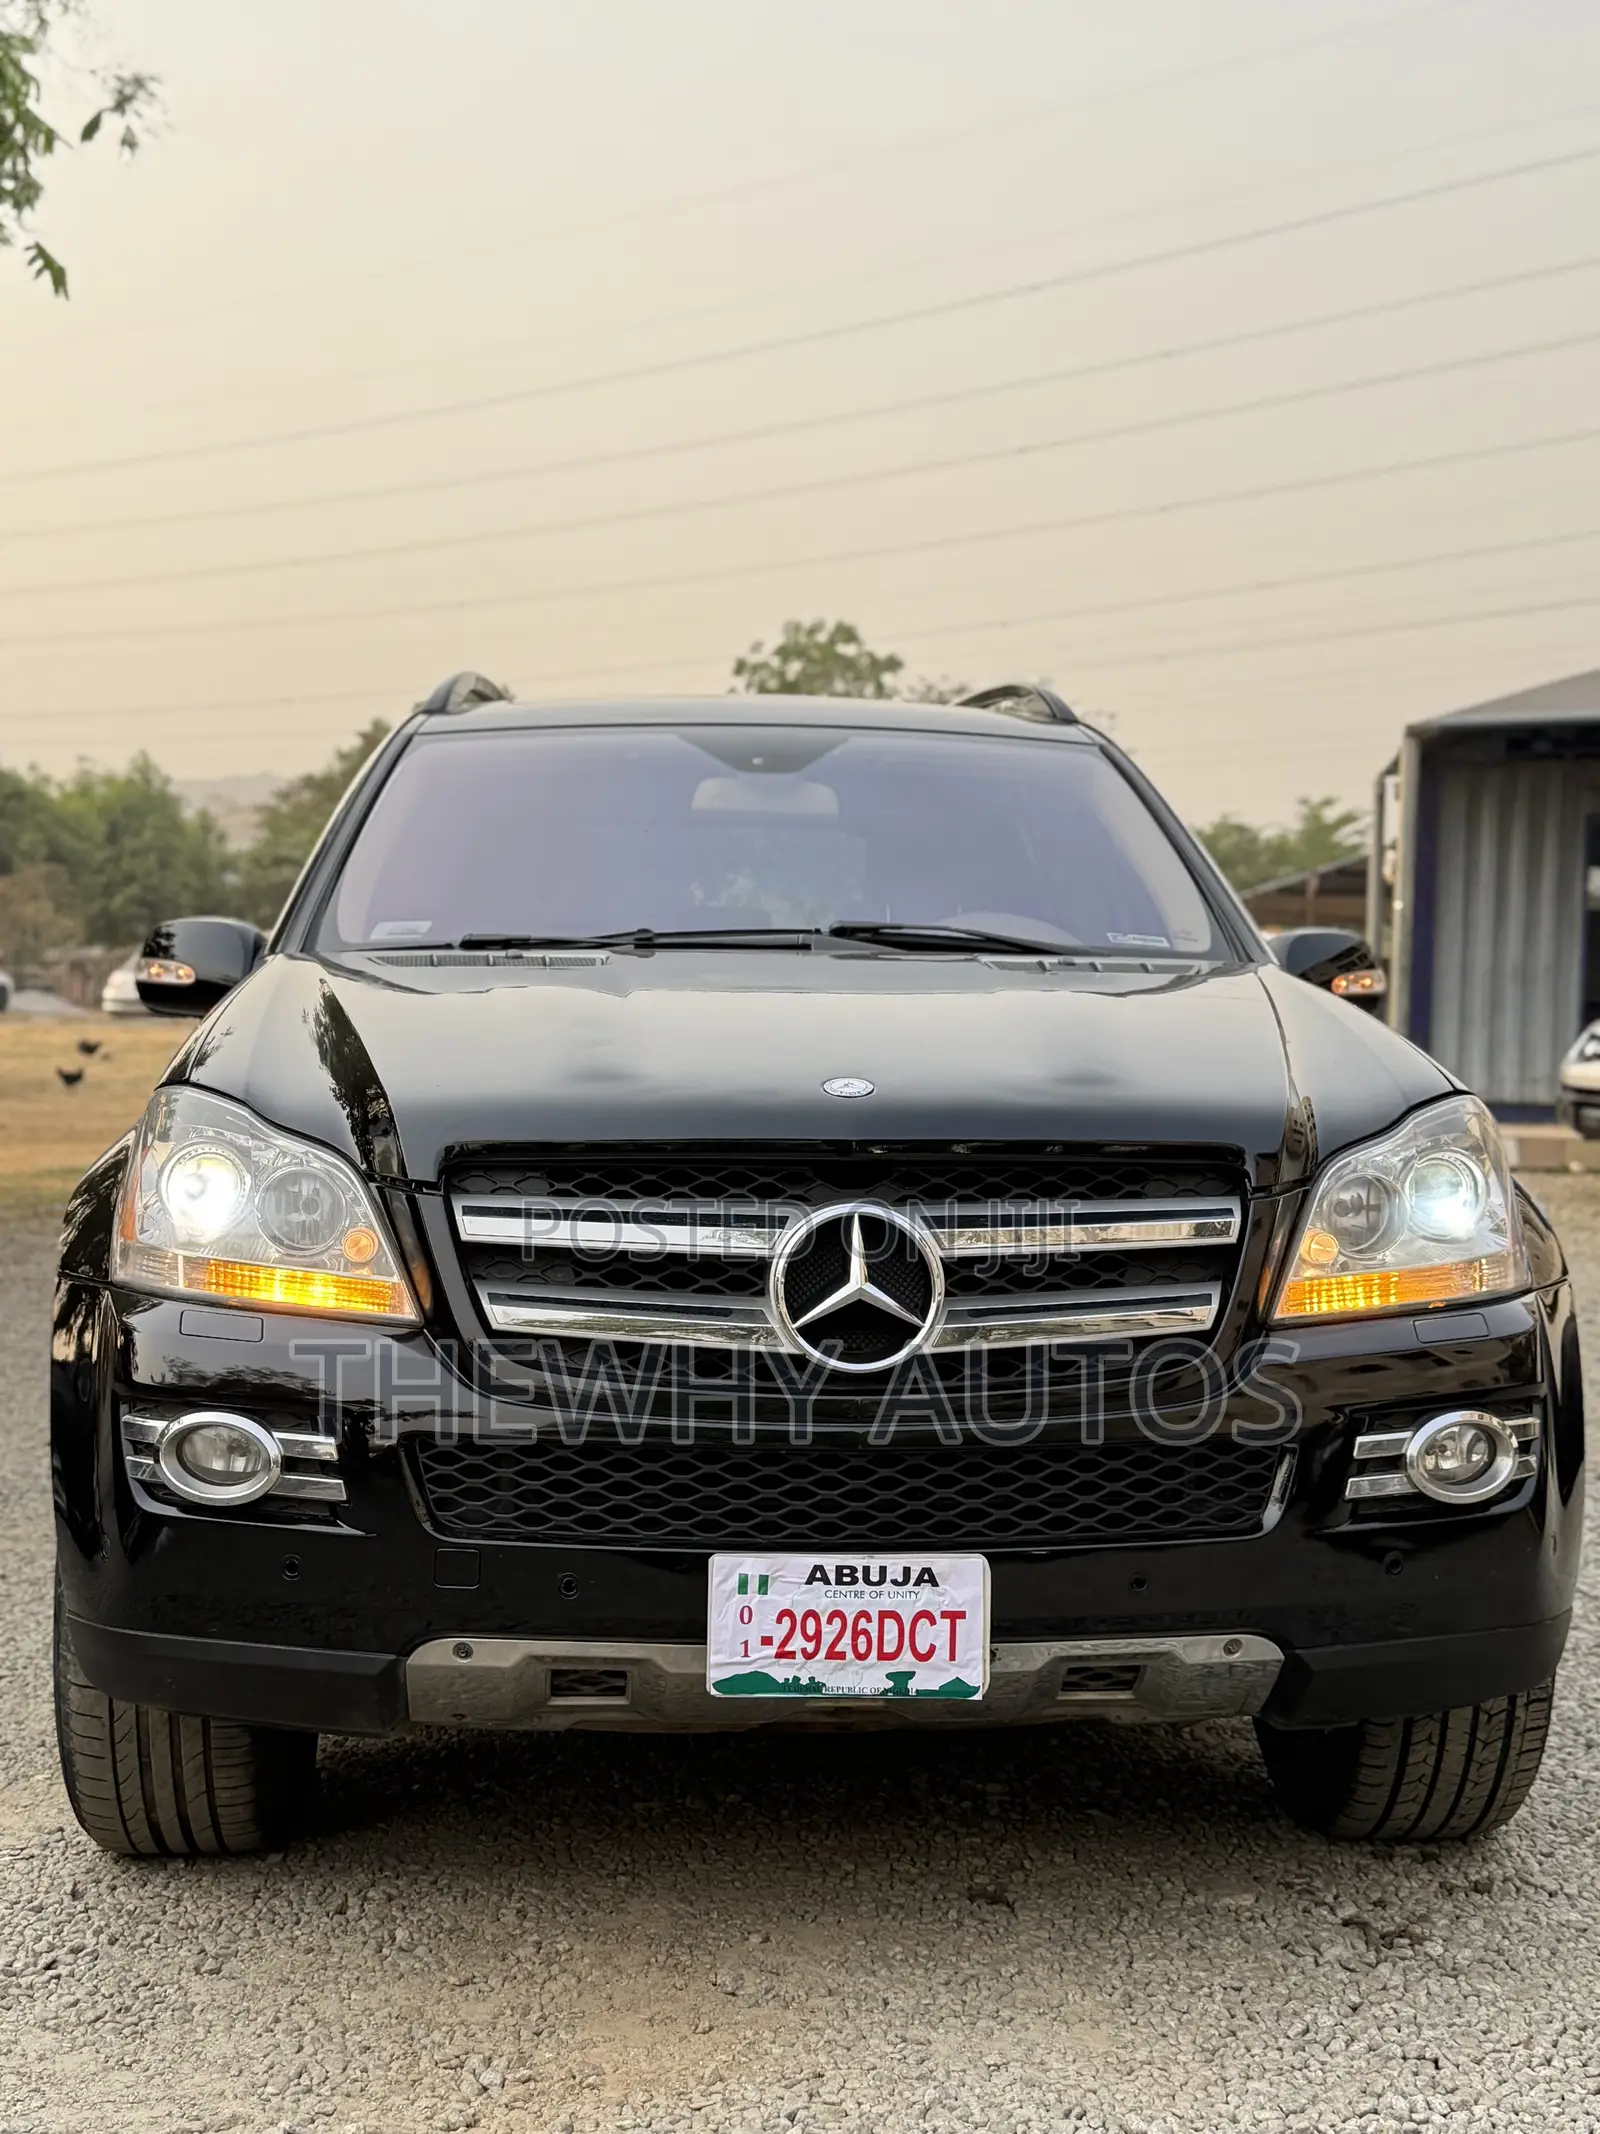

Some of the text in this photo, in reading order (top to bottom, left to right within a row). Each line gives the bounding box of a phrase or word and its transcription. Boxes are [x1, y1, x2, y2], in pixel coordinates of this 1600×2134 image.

[804, 1564, 940, 1587] ABUJA
[824, 1589, 920, 1600] CENTRE OF UNITY
[824, 1685, 868, 1694] REPUBLIC
